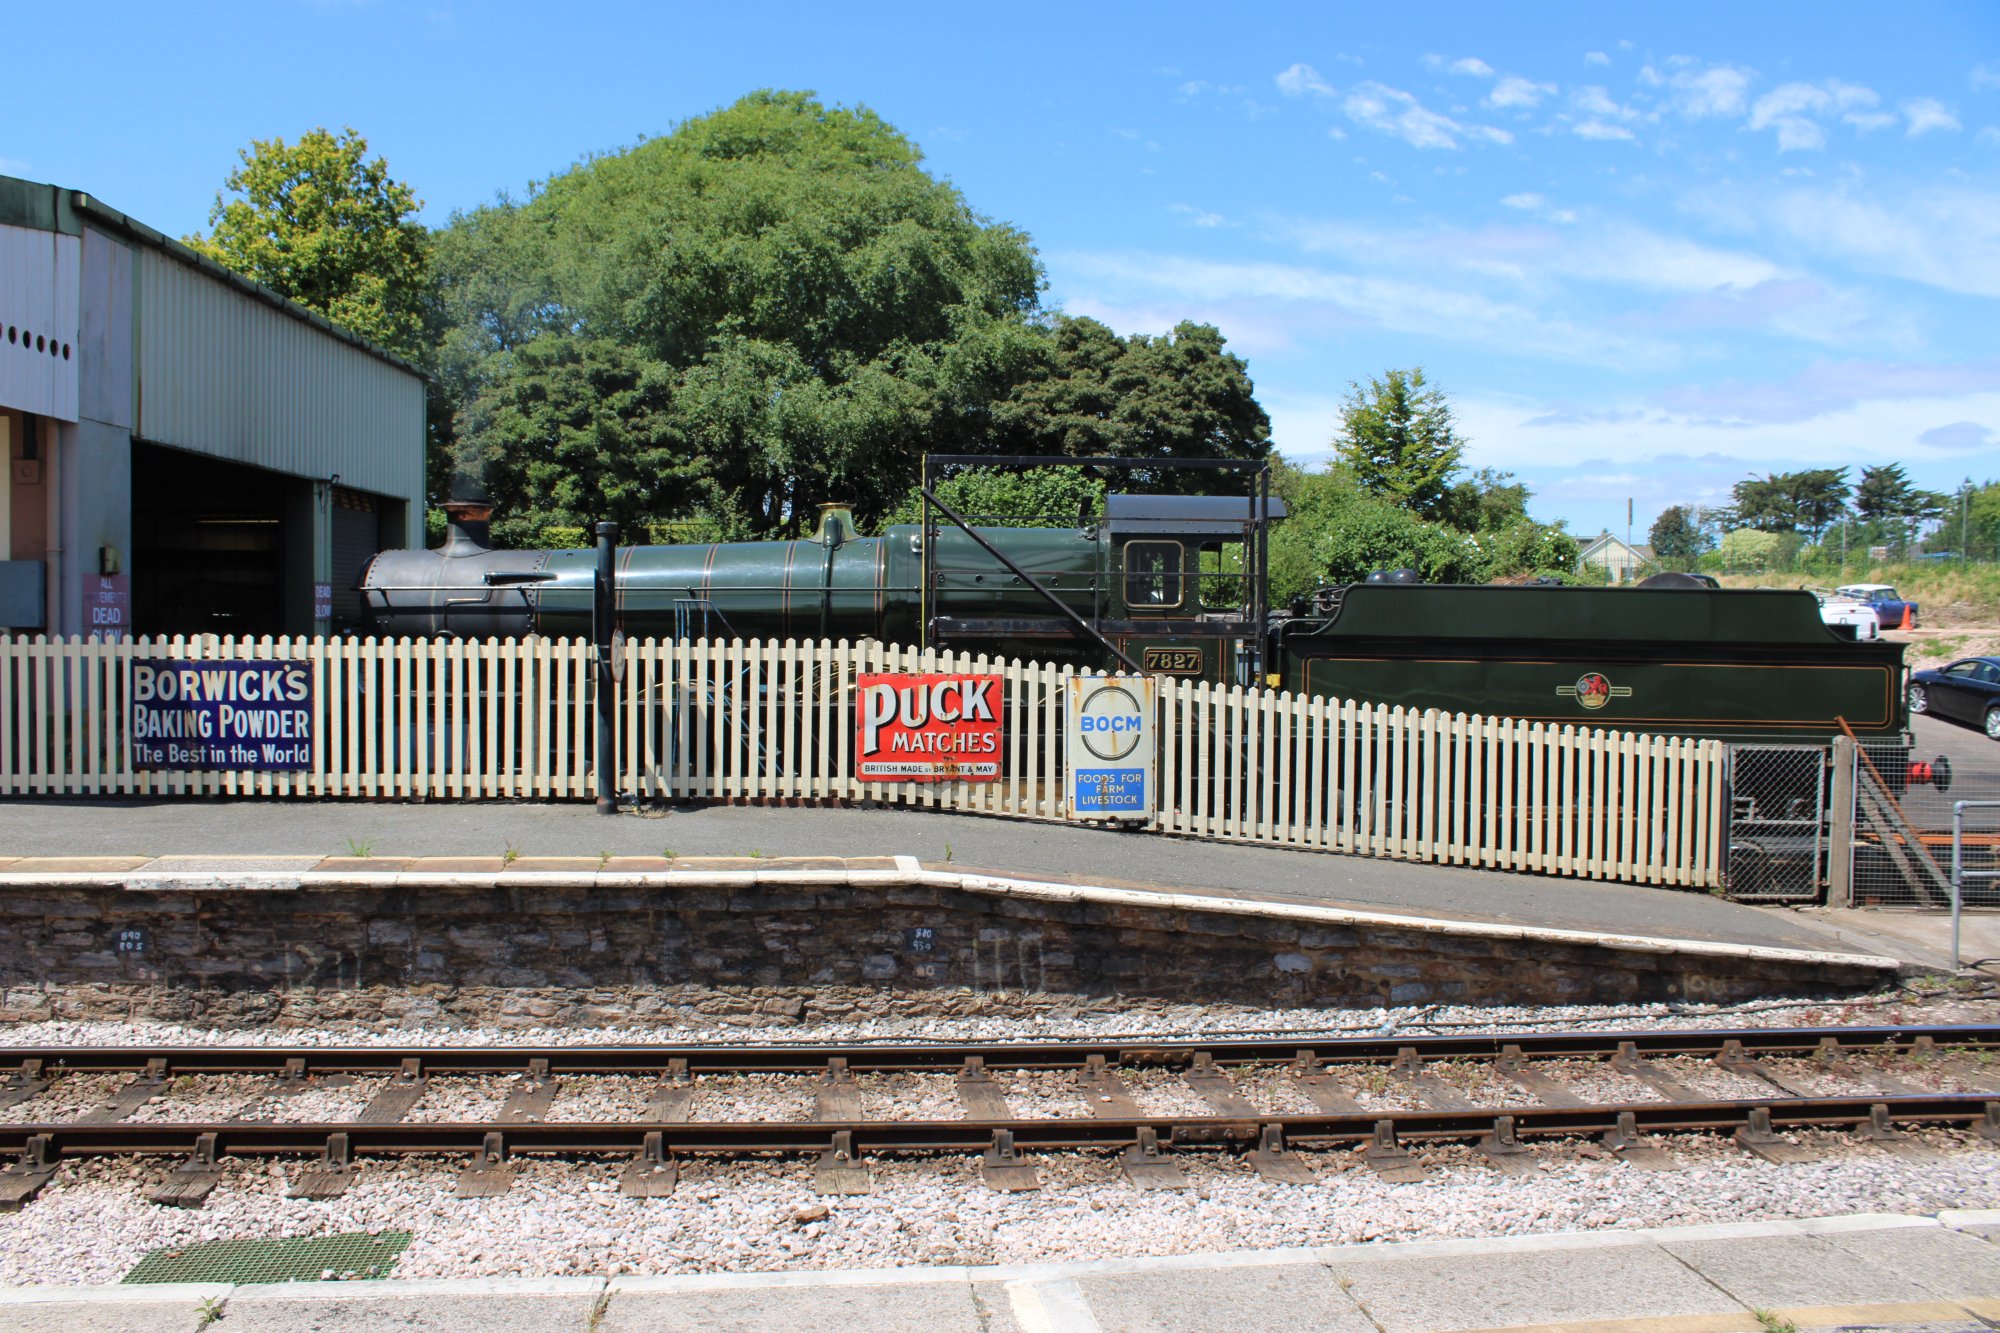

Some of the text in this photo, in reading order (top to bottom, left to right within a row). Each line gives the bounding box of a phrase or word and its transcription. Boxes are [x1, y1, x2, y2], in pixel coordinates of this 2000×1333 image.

[101, 577, 113, 589] ALL
[93, 607, 121, 624] DEAD
[1148, 653, 1198, 669] 7827
[134, 664, 308, 702] BORWICK'S
[134, 704, 309, 738] BAKING POWDER
[863, 679, 997, 757] PUCK
[1080, 715, 1142, 732] BOCM
[891, 732, 997, 753] MATCHES
[134, 743, 309, 763] The Best in the World
[865, 764, 898, 772] BRITISH
[900, 764, 923, 772] MADE
[933, 764, 965, 773] BRYANT
[967, 764, 973, 772] &
[975, 764, 993, 772] MAY
[1078, 773, 1142, 783] FOODS FOR
[1096, 784, 1125, 794] FARM
[1082, 795, 1137, 805] LIVESTOCK
